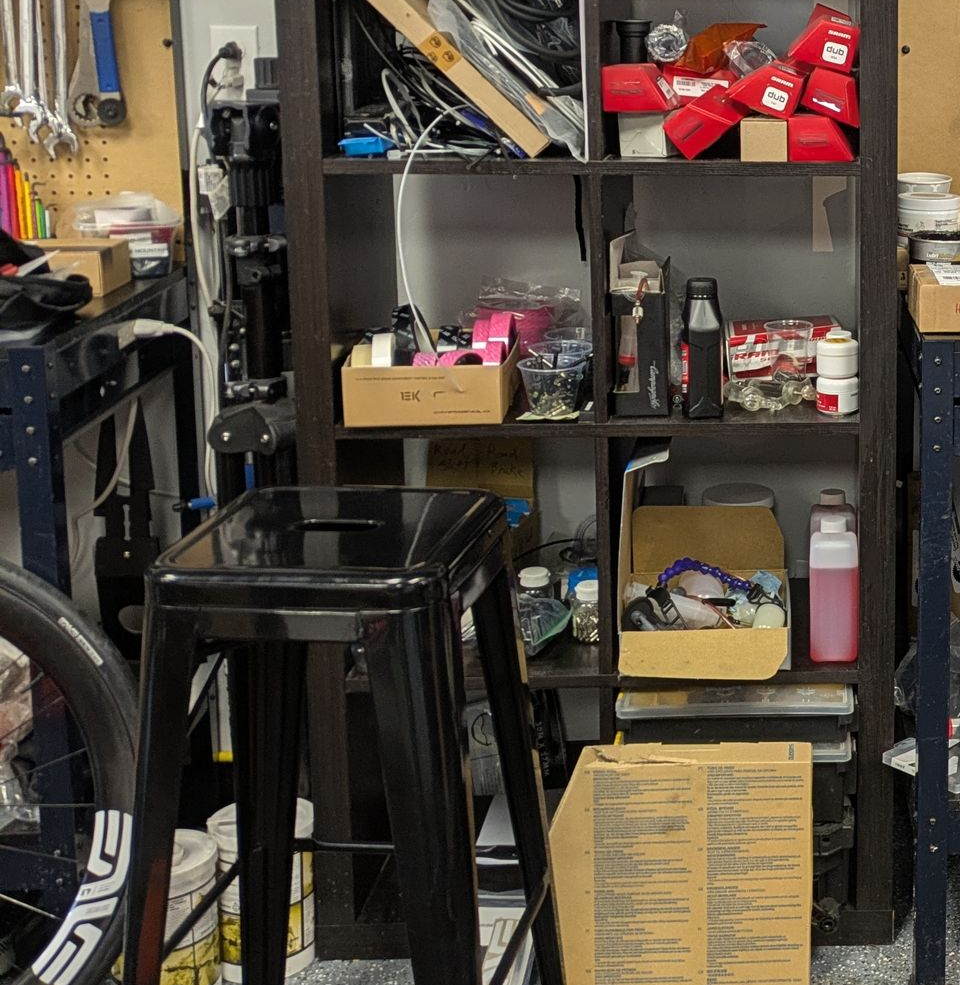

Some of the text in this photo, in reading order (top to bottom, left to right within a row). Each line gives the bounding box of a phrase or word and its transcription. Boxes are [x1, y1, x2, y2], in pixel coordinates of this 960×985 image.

[827, 29, 851, 40] SRAM
[826, 45, 845, 56] dub
[770, 75, 794, 88] SRAM
[767, 91, 786, 103] dub
